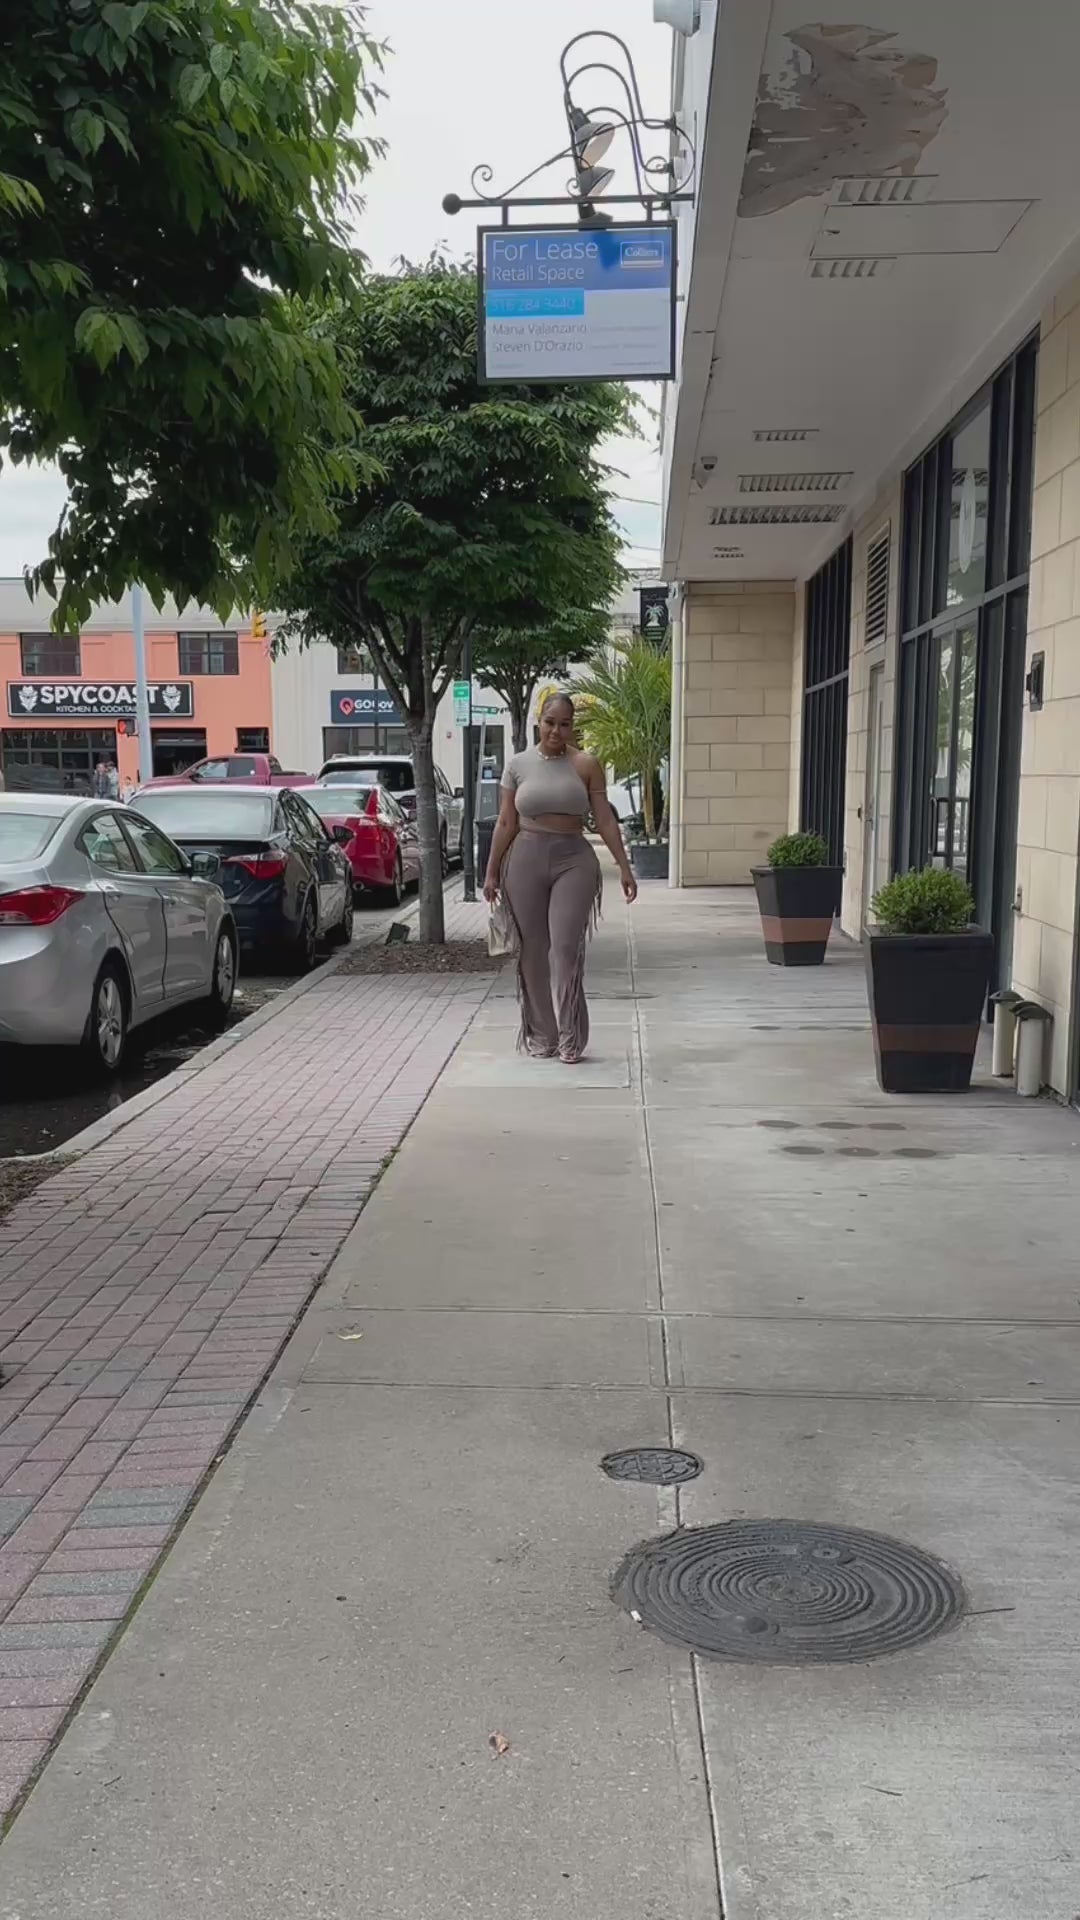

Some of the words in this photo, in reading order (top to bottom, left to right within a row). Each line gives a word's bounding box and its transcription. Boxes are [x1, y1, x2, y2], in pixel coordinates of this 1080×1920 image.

[492, 239, 529, 261] For
[535, 239, 600, 261] Lease
[492, 265, 534, 282] Retail
[538, 264, 585, 284] Space
[493, 340, 532, 353] Steven
[56, 705, 91, 713] KITCHEN
[92, 705, 99, 713] &
